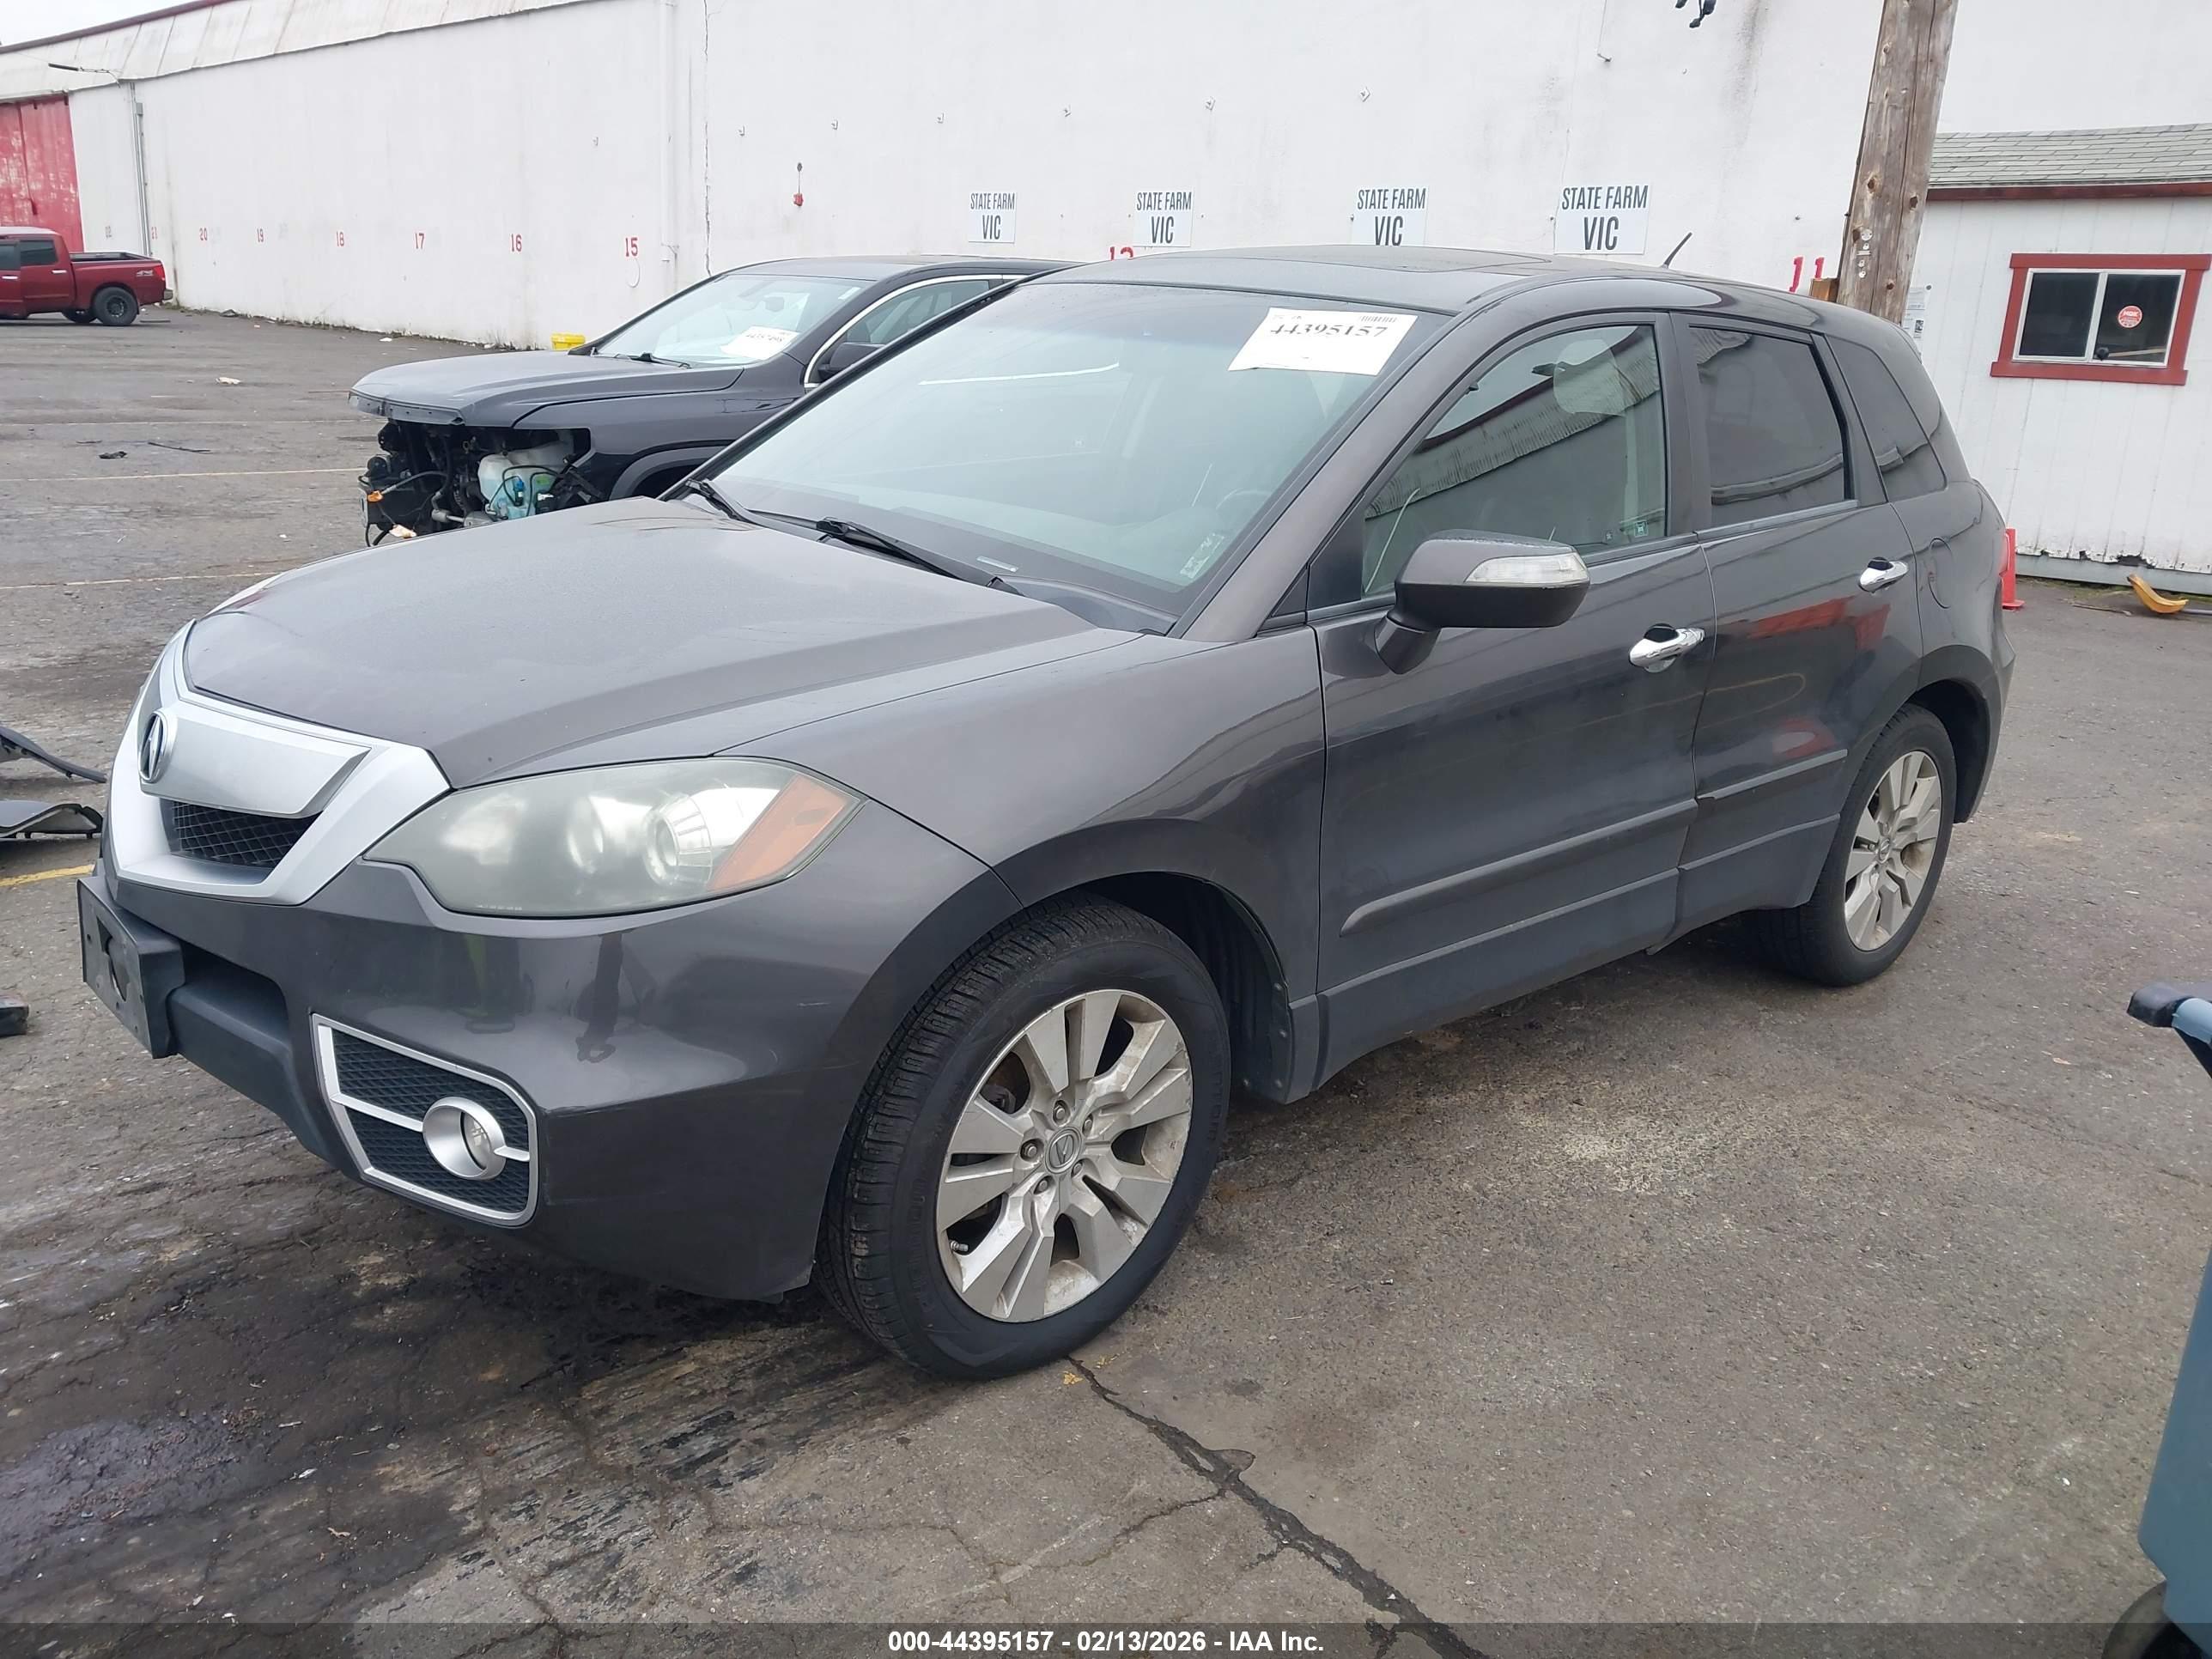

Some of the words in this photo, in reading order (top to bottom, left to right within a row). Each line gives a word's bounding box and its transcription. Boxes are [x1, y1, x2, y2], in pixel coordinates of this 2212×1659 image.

[970, 192, 992, 210] STATE
[993, 192, 1015, 210] FARM
[1136, 191, 1163, 211] STATE
[1164, 191, 1192, 211] FARM
[1357, 188, 1389, 210] STATE
[1391, 188, 1426, 210] FARM
[1561, 185, 1602, 211] STATE
[1604, 185, 1649, 210] FARM
[199, 228, 208, 241] 20
[257, 228, 264, 243] 19
[981, 215, 1001, 240] VIC
[1151, 216, 1175, 244] VIC
[1374, 216, 1404, 246] VIC
[1583, 216, 1620, 251] VIC
[336, 231, 345, 246] 18
[415, 233, 425, 250] 17
[510, 234, 522, 252] 16
[625, 237, 638, 257] 15
[1270, 324, 1389, 337] 44395157
